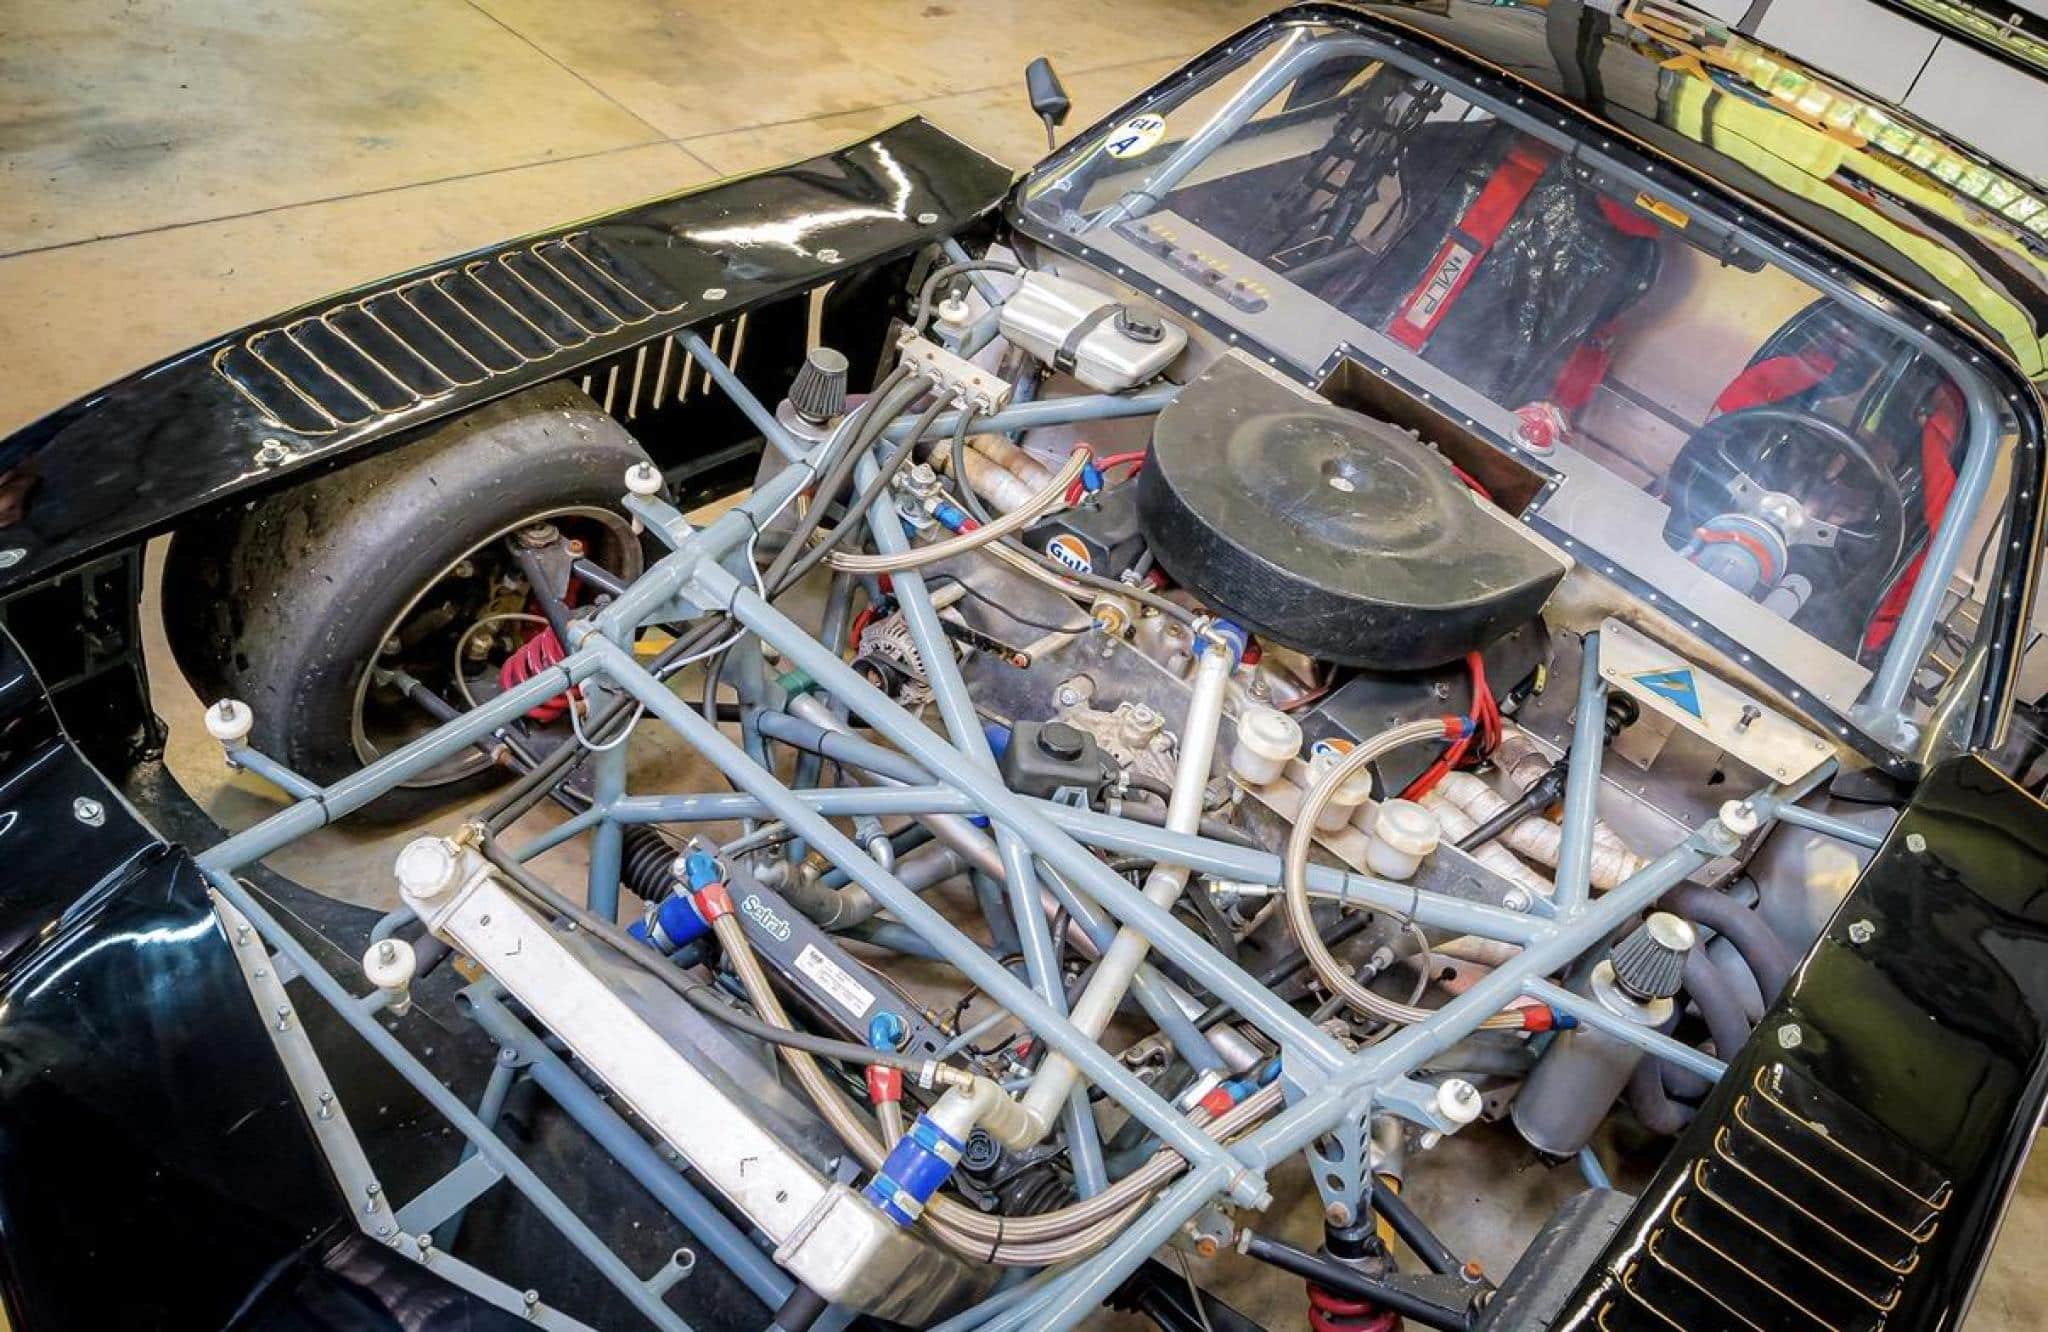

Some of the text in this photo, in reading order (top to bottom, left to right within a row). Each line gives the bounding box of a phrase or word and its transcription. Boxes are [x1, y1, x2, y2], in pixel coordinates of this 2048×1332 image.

[1109, 136, 1139, 155] A
[1050, 543, 1089, 572] Gulf
[742, 895, 791, 942] Setrab
